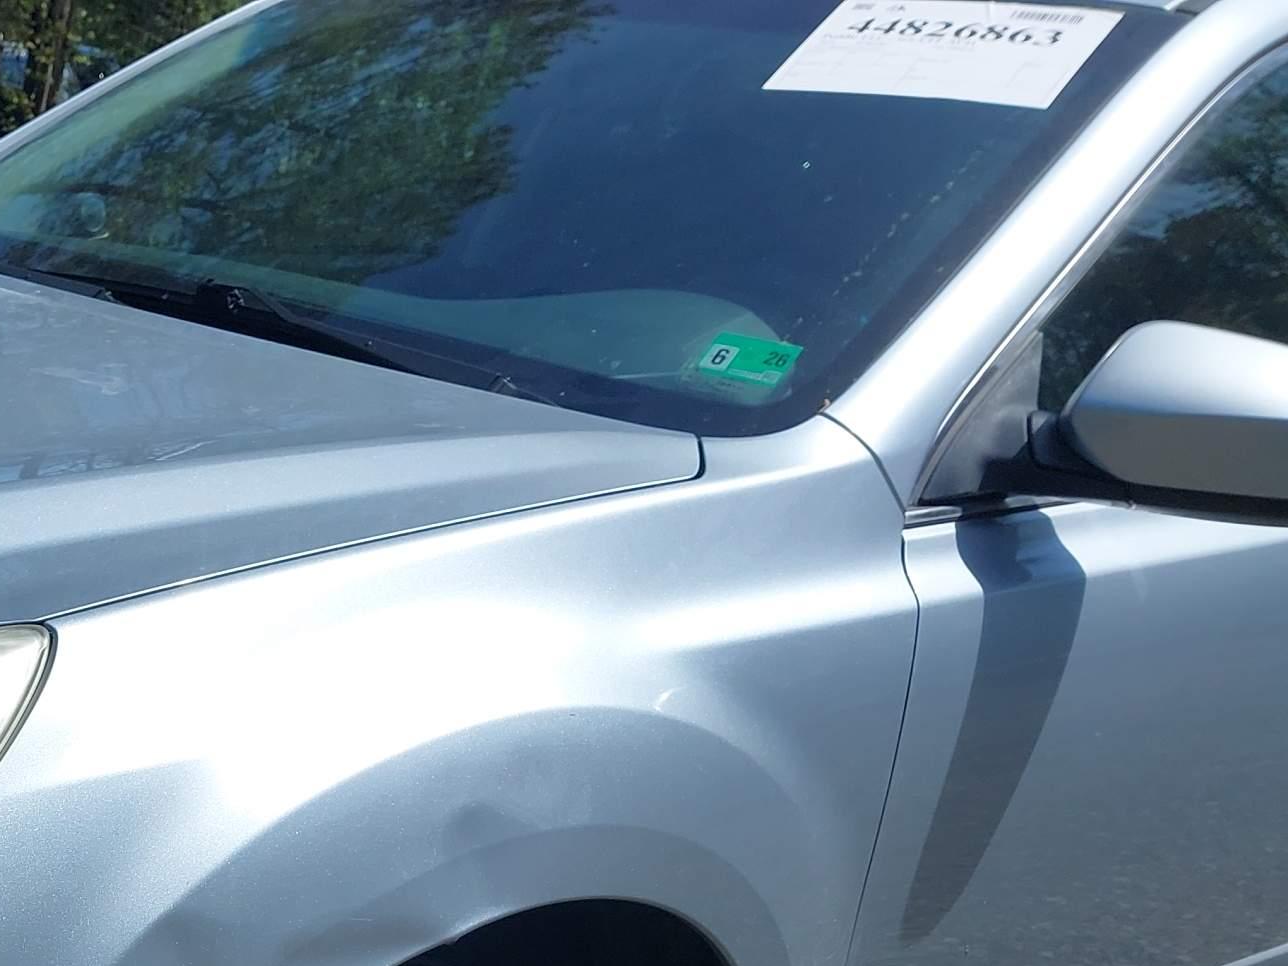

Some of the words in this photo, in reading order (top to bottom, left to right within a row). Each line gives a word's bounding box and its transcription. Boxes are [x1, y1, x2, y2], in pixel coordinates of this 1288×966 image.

[847, 17, 1064, 47] 44826863
[711, 348, 730, 365] 6
[763, 351, 790, 367] 26
